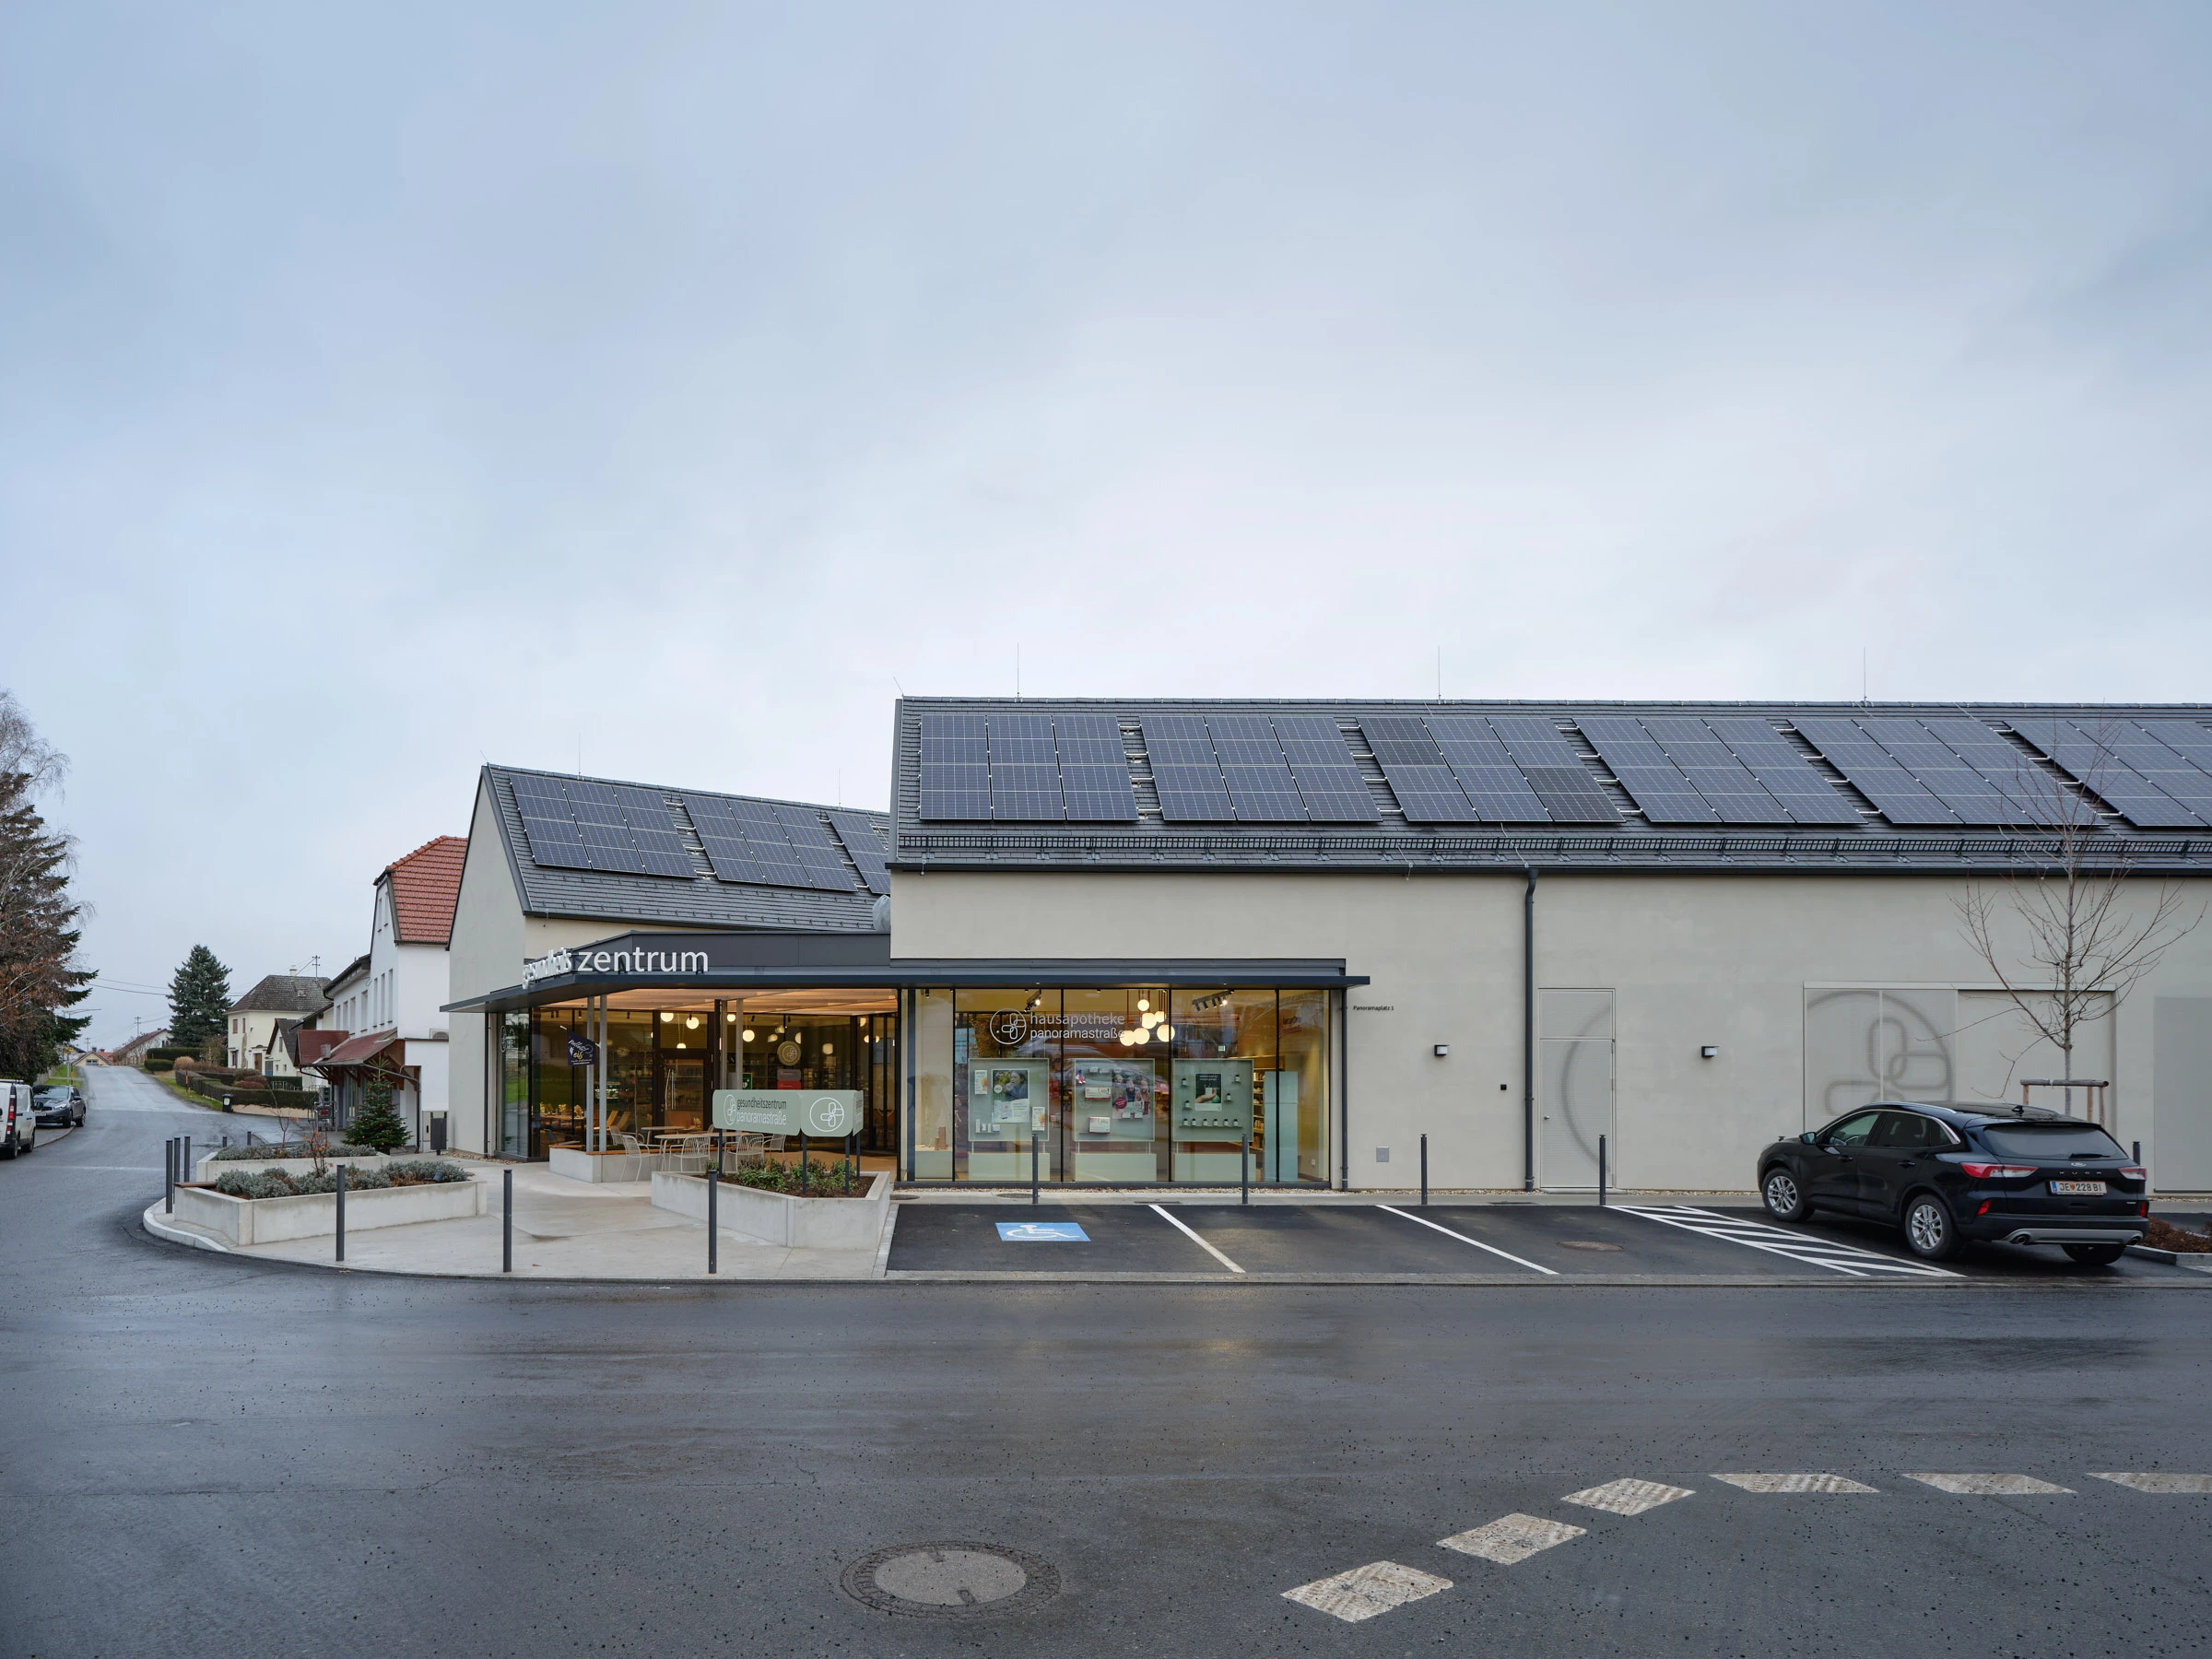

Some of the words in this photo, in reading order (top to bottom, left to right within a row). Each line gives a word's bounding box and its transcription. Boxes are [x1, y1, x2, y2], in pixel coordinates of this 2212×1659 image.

[577, 947, 709, 973] zentrum
[1030, 1012, 1125, 1028] hausapotheke
[1030, 1027, 1125, 1041] panoramastraße
[736, 1097, 787, 1111] gesundheitszentrum
[735, 1110, 787, 1126] panoramastraße
